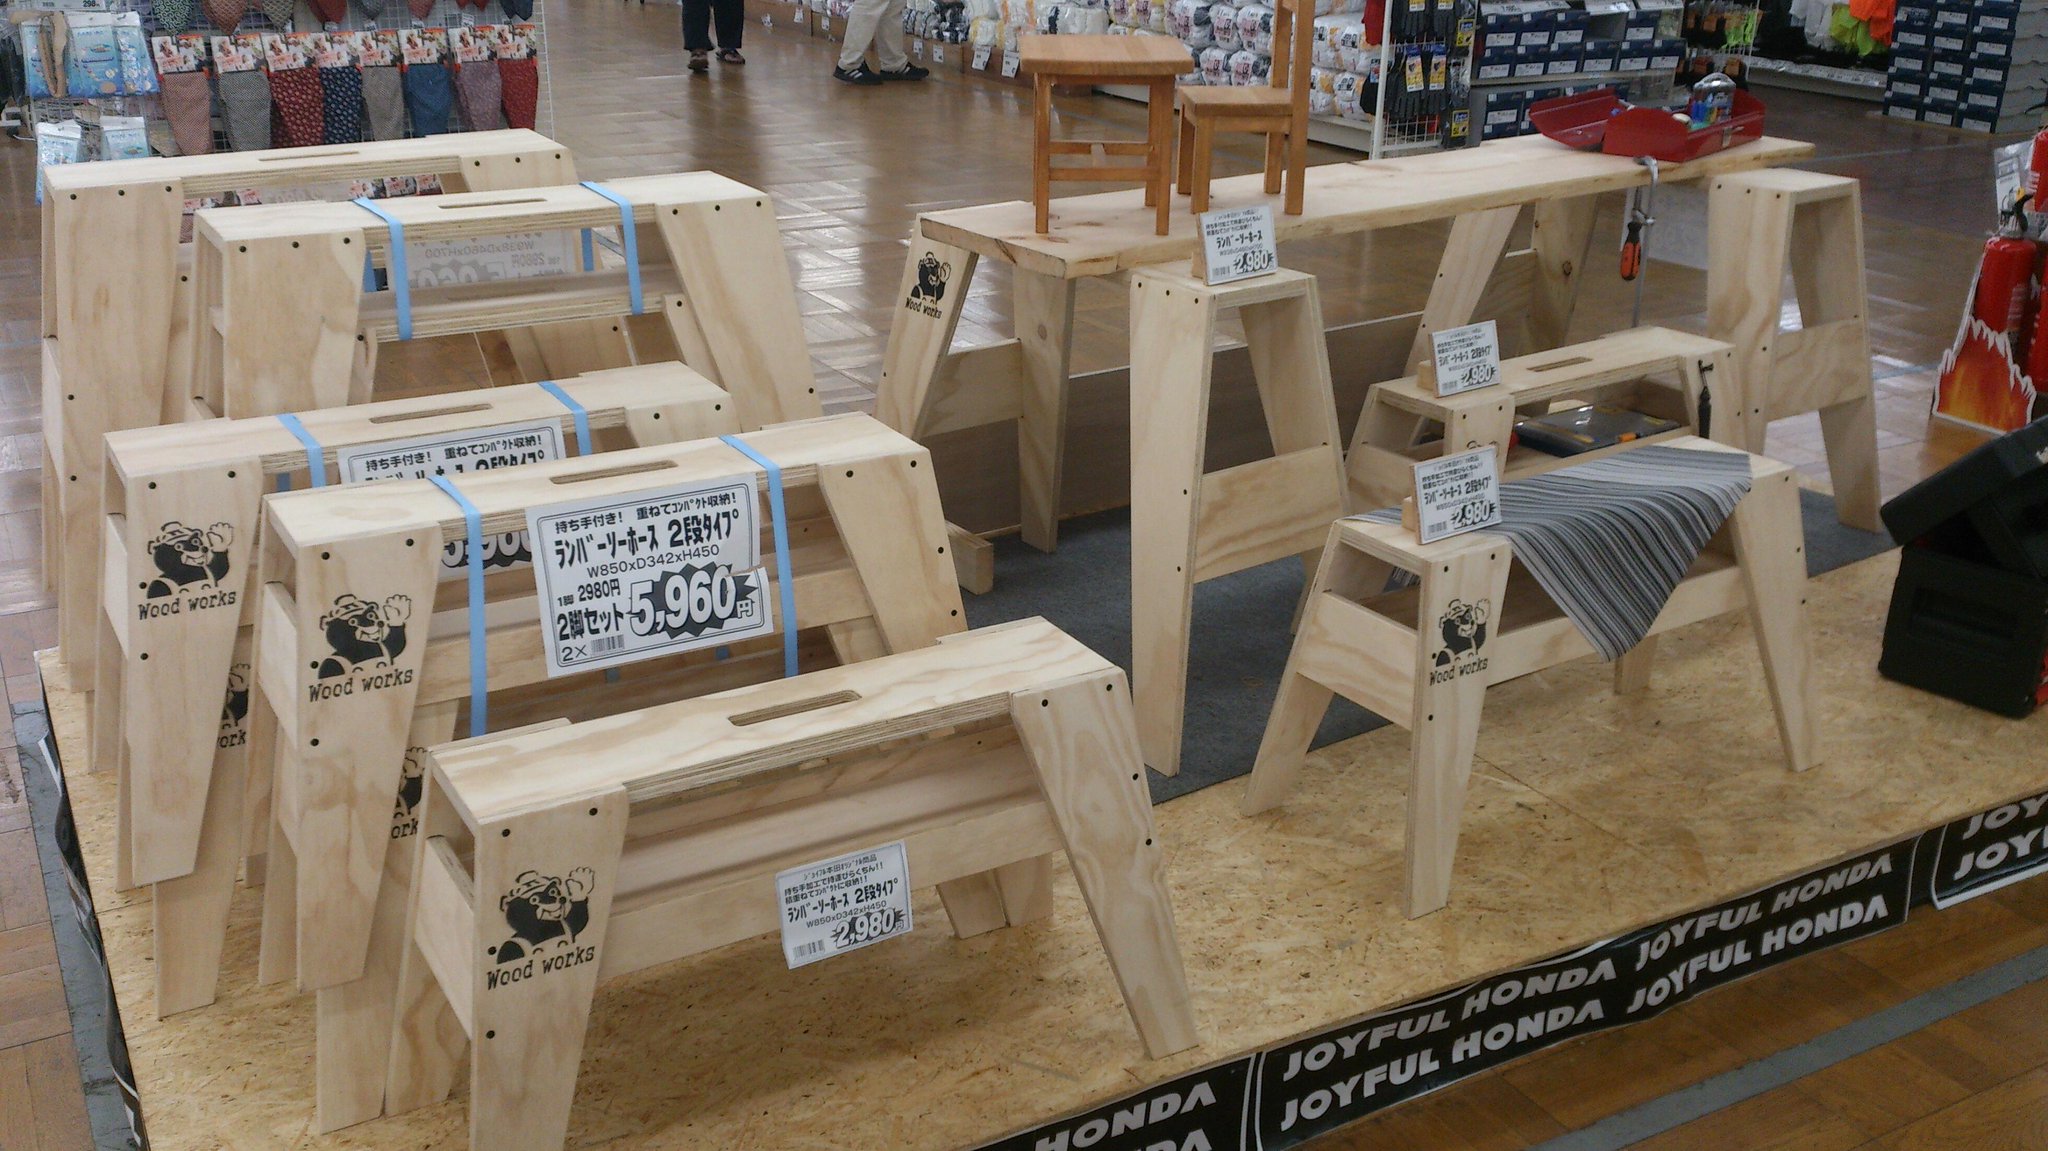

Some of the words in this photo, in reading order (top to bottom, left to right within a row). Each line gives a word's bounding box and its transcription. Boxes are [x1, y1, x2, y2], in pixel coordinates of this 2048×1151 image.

[905, 297, 922, 312] Wood
[923, 305, 942, 319] works
[554, 524, 659, 569] ランバーリーホース
[667, 508, 740, 548] 2段タイプ
[587, 544, 720, 579] W850xD342xH450
[137, 598, 180, 620] Wood
[188, 590, 236, 612] works
[578, 577, 620, 602] 2980円
[557, 602, 624, 641] 2脚セット
[308, 678, 353, 702] Wood
[362, 669, 413, 692] works
[1429, 665, 1455, 686] Wood
[1459, 658, 1488, 677] works
[787, 893, 849, 922] ランバーリーホース
[854, 877, 898, 904] 2段タイプ
[806, 900, 886, 928] W850xD342xH450
[486, 960, 533, 990] Wood
[542, 946, 595, 974] works
[1282, 1009, 1451, 1081] JOYFUL
[1462, 958, 1616, 1020] HONDA
[1635, 900, 1761, 971] JOYFUL
[1771, 854, 1893, 914] HONDA
[1280, 1048, 1440, 1131] JOYFUL
[1451, 999, 1605, 1063] HONDA
[1626, 940, 1751, 1014] JOYFUL
[1761, 894, 1889, 956] HONDA
[1035, 1081, 1217, 1151] HONDA
